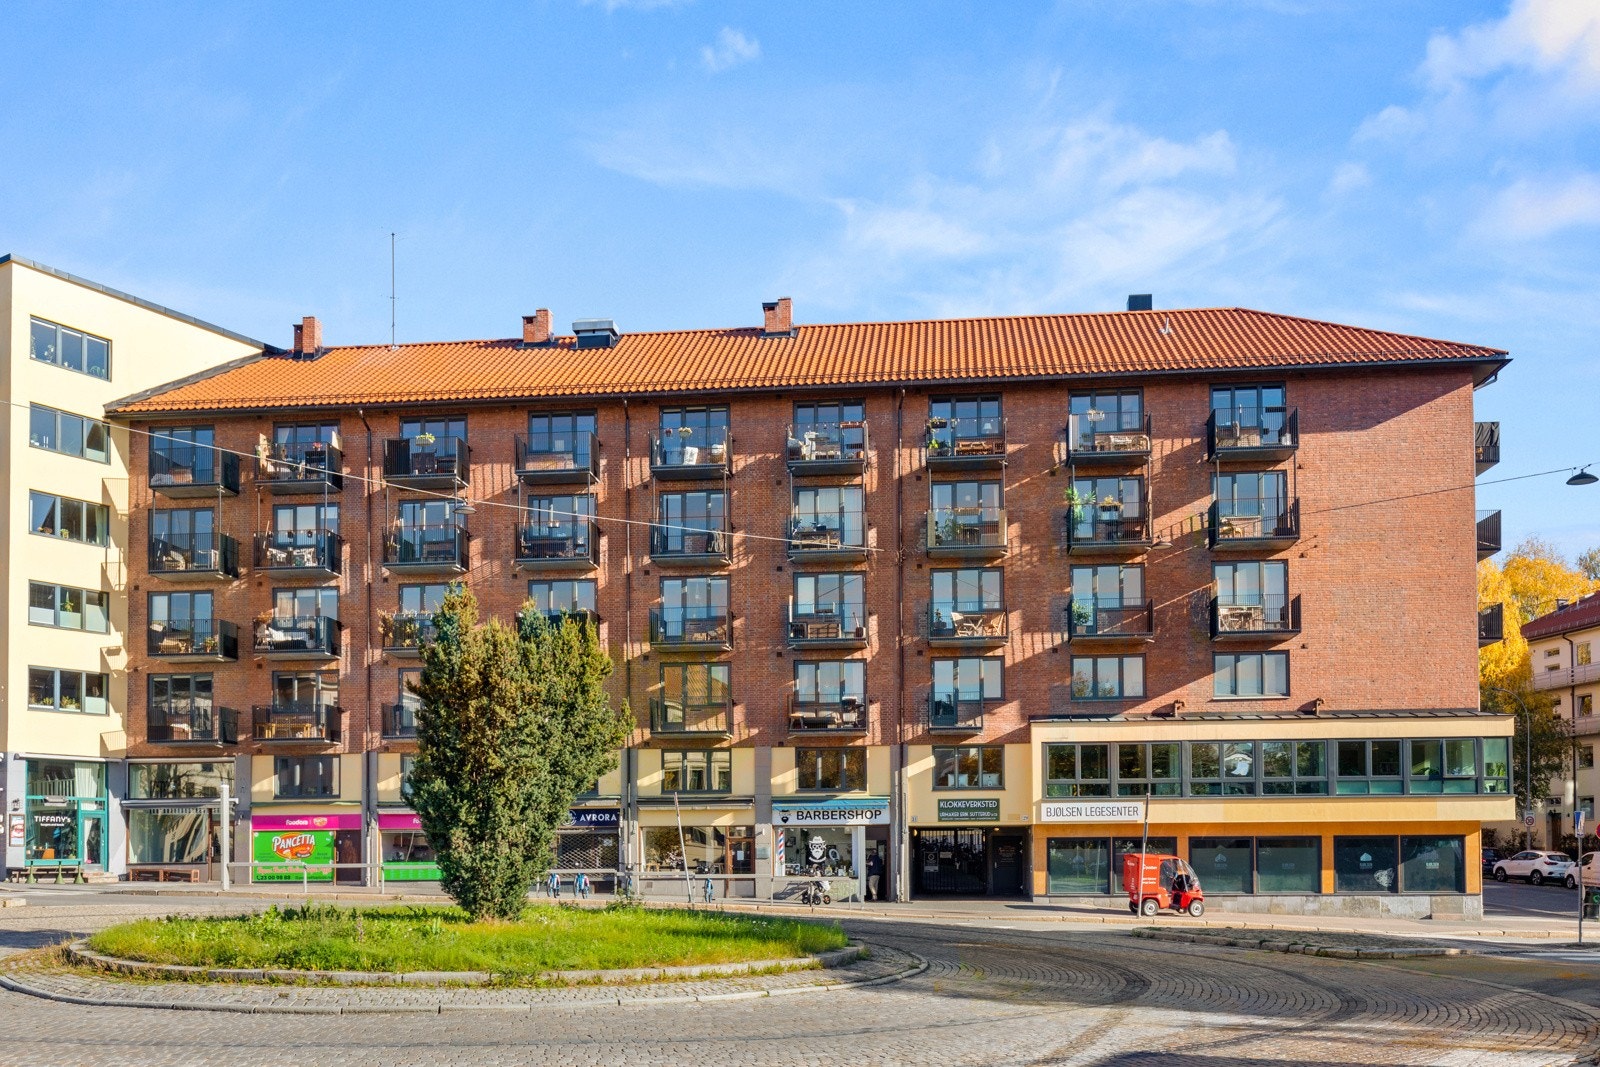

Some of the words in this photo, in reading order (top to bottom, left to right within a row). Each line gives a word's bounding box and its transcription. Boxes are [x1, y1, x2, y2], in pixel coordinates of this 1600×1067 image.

[939, 800, 998, 808] KLOKKEVERKSTED
[796, 809, 882, 820] BARBERSHOP
[1046, 806, 1083, 817] BJØLSEN
[1085, 806, 1139, 817] LEGESENTER
[580, 813, 617, 822] AVRORA
[272, 834, 316, 852] PANCETTA
